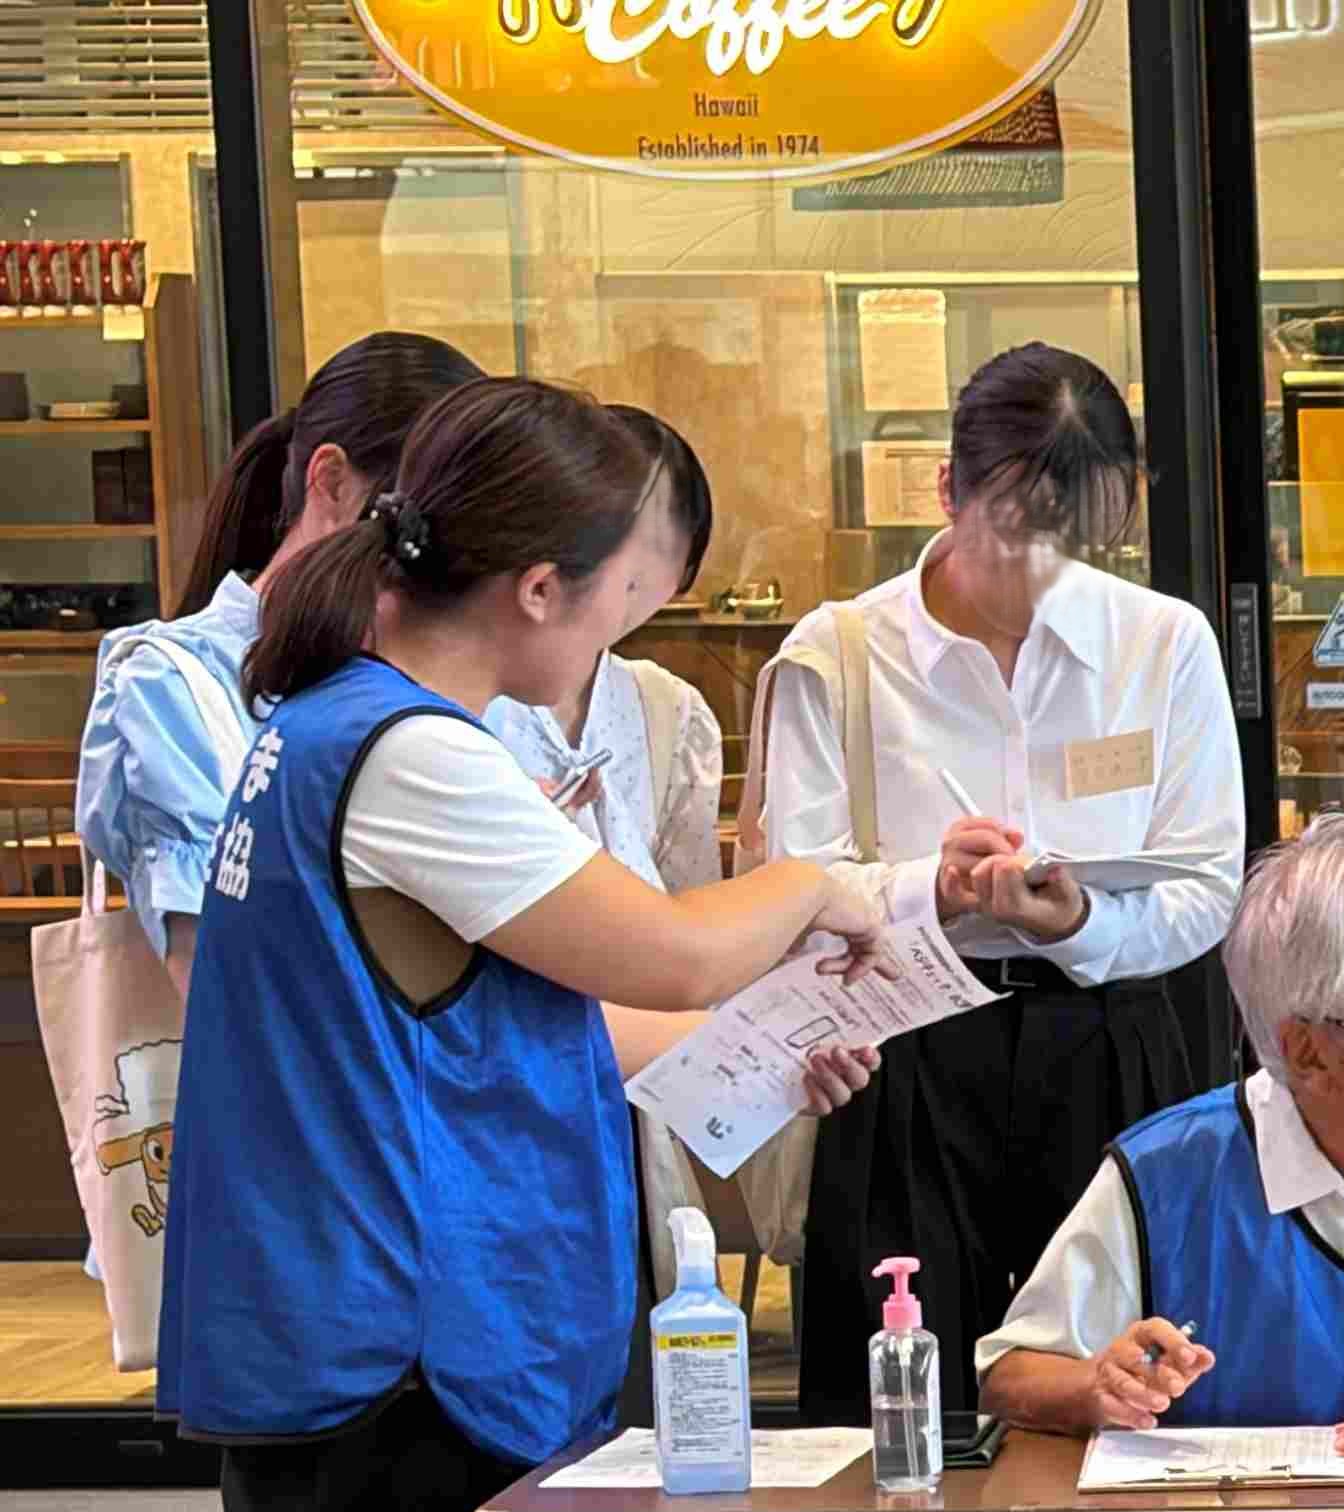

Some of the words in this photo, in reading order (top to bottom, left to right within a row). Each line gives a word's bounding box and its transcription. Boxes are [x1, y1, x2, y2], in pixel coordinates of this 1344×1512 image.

[693, 93, 760, 118] Hawaii
[637, 135, 743, 160] Established
[750, 135, 768, 157] in
[777, 135, 820, 157] 1974
